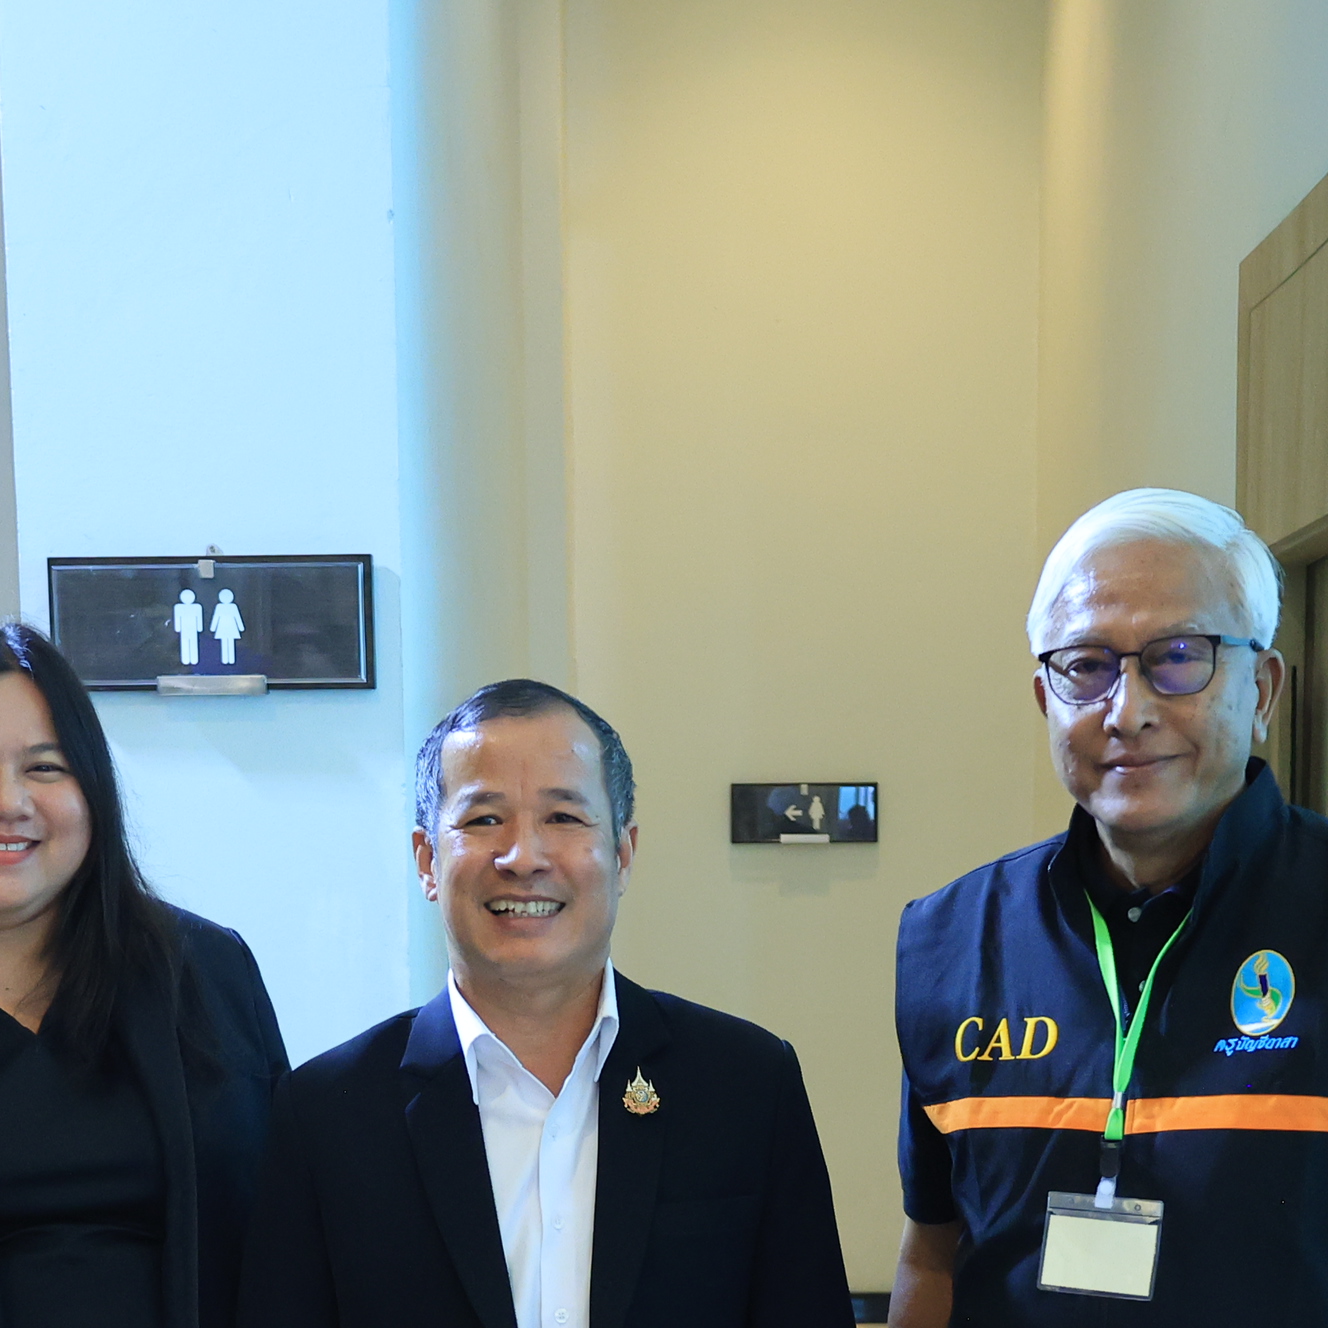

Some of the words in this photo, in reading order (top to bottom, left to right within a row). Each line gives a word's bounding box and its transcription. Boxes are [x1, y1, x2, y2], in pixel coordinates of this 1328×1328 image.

[955, 1016, 1059, 1062] CAD
[1213, 1034, 1299, 1057] ครูบัญชีอาสา
